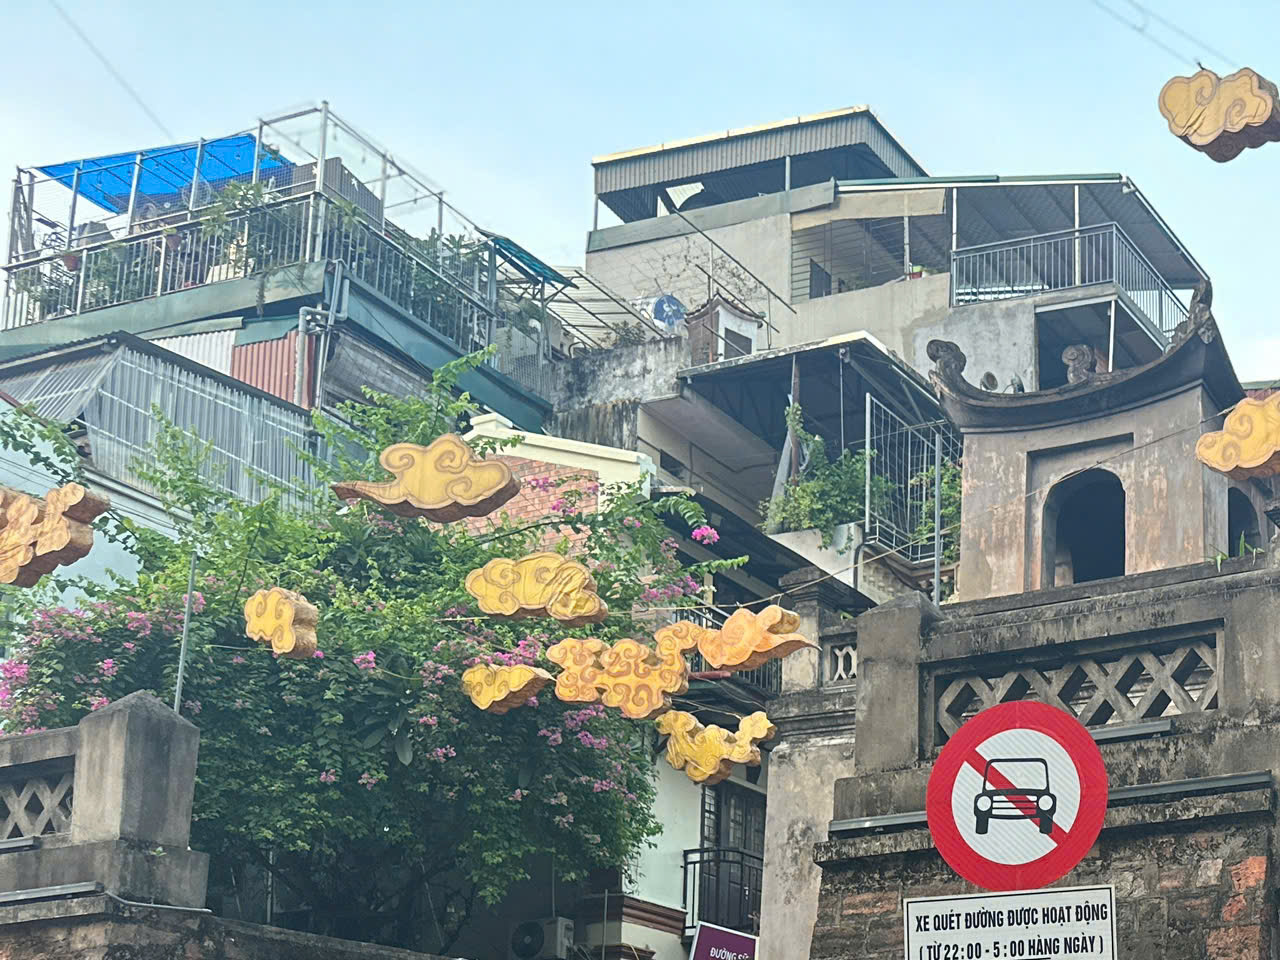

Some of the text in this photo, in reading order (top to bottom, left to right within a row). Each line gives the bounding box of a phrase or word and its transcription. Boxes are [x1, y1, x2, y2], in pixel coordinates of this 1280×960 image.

[915, 900, 1108, 932] XE QUÉT ĐƯỜNG ĐƯỢC HOẠT ĐỘNG
[1028, 934, 1060, 956] HÀNG
